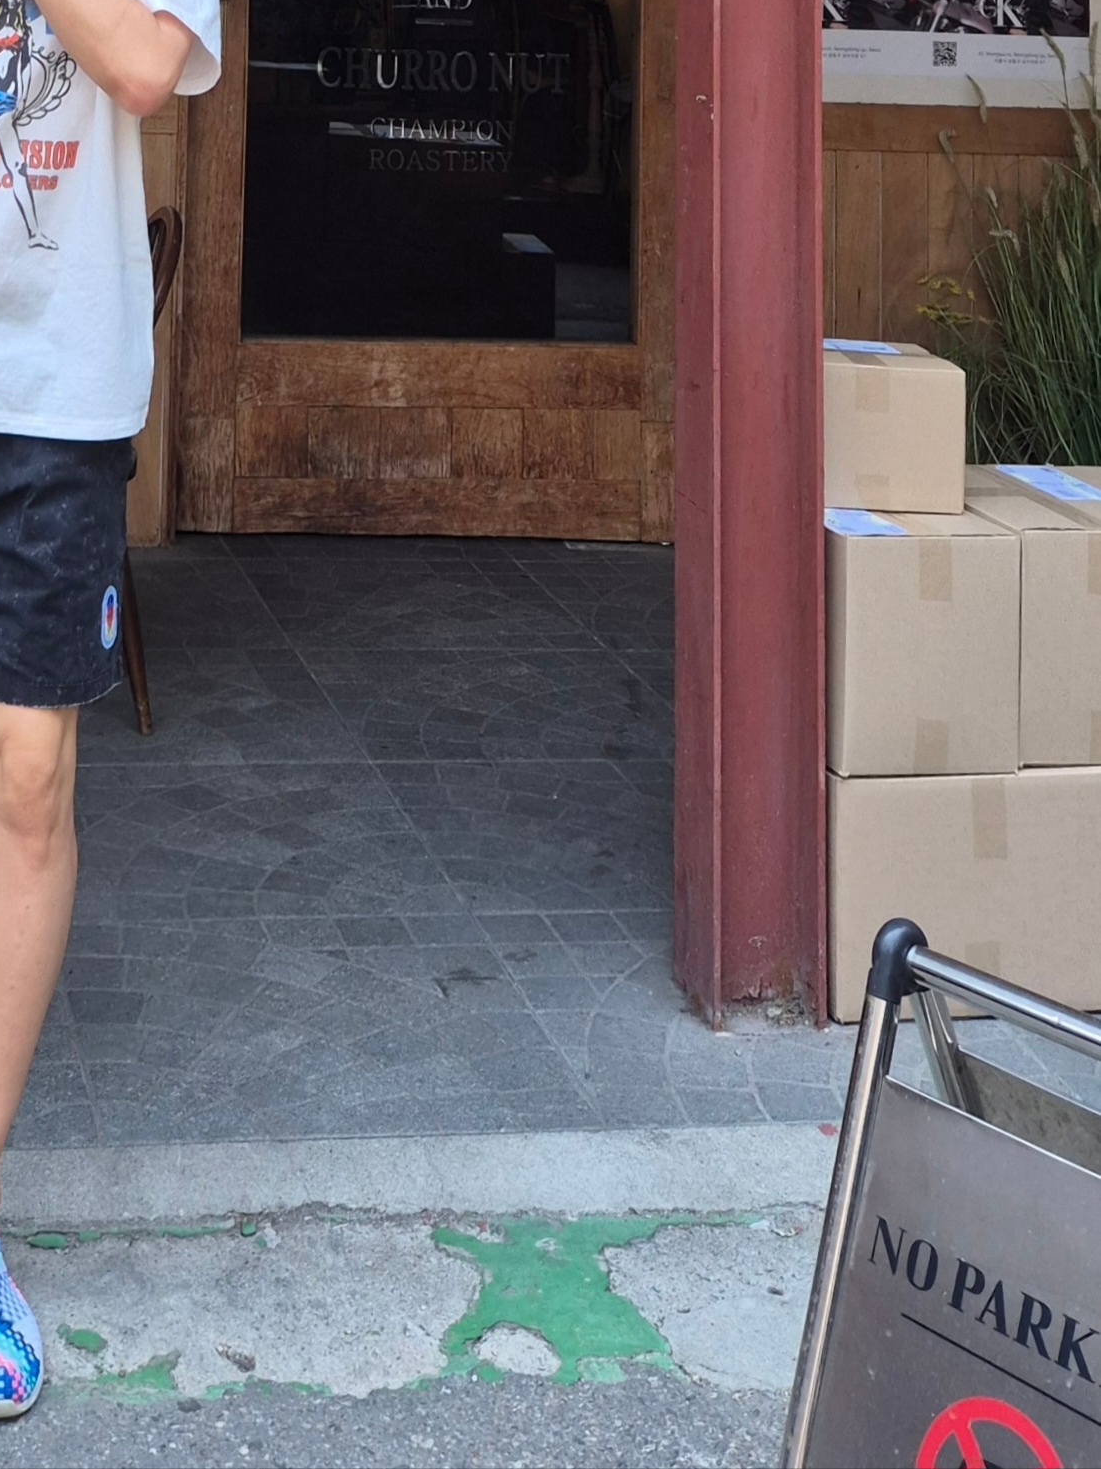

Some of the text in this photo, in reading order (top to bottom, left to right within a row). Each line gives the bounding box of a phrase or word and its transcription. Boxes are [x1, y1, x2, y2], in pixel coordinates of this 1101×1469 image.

[316, 46, 571, 95] CHURRO NUT
[369, 116, 514, 143] CHAMPION
[20, 139, 80, 171] ISION
[369, 148, 515, 174] ROASTERY
[867, 1214, 1101, 1386] NO PARK
